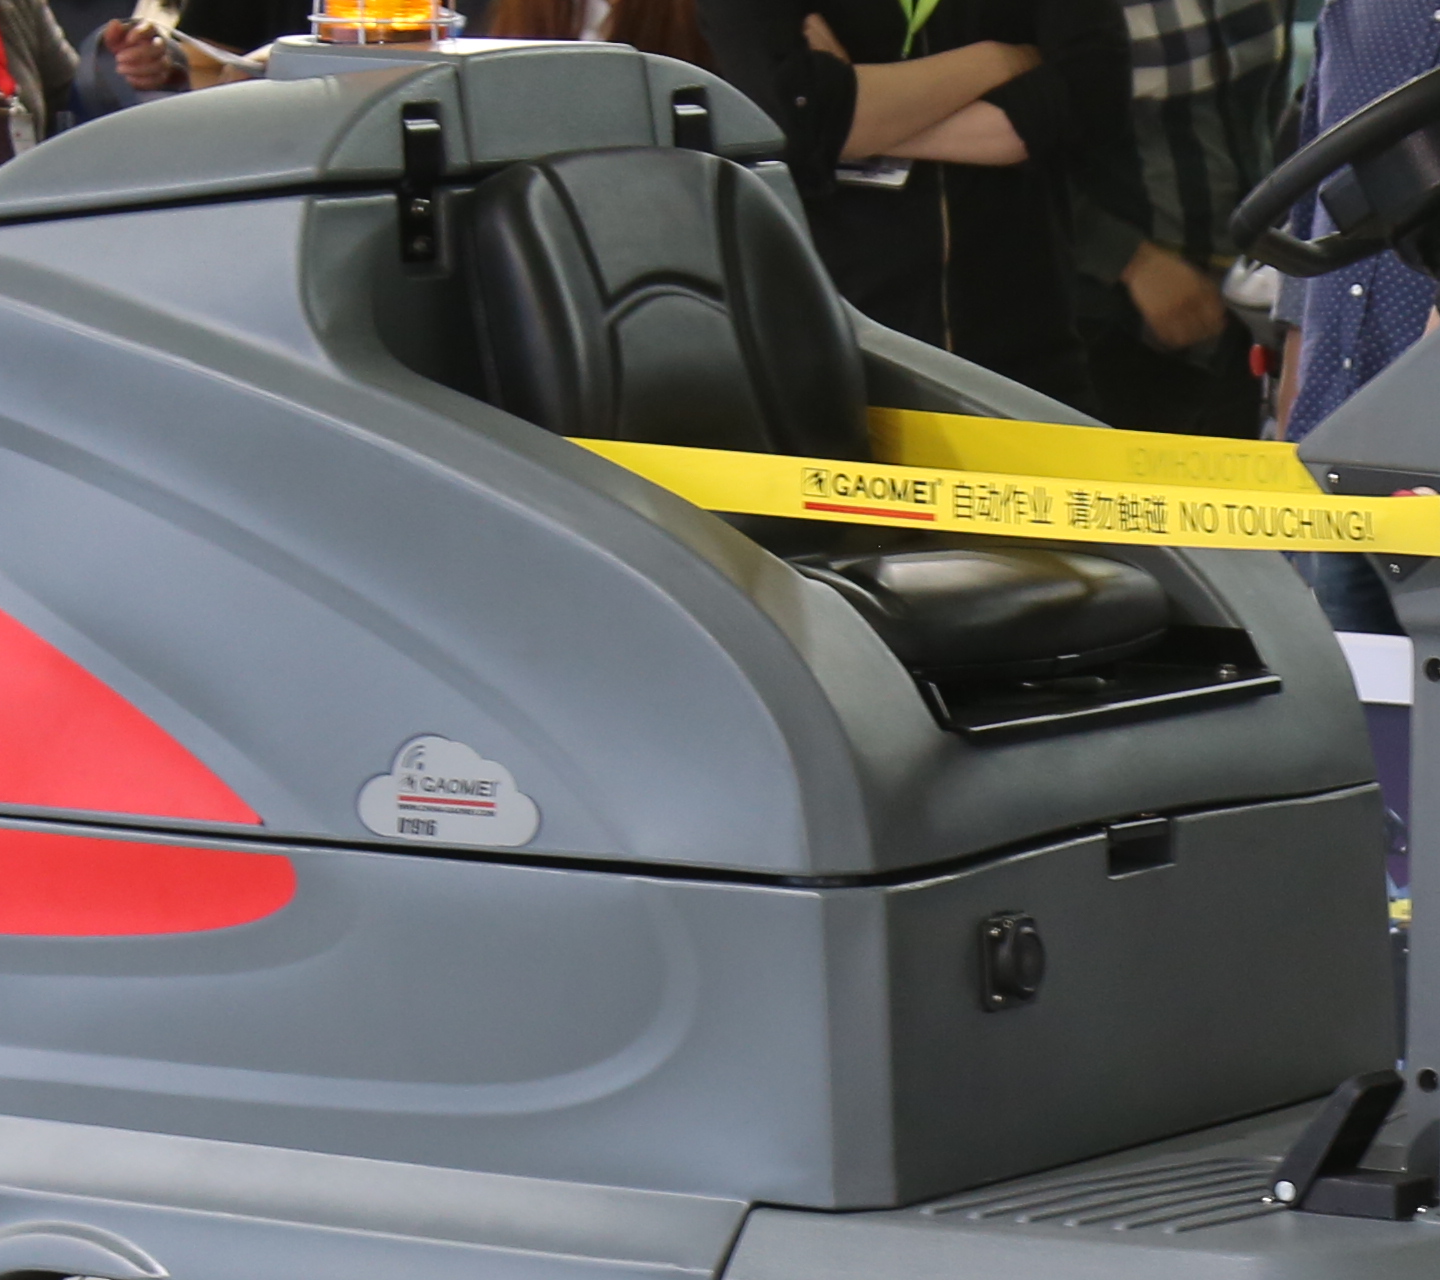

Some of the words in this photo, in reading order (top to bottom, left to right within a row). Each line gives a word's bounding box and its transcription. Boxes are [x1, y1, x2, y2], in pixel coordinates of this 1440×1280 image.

[832, 472, 937, 506] GAOMEI
[953, 480, 1054, 526] 自动作业
[1063, 489, 1170, 535] 请勿触碰
[1178, 500, 1220, 534] NO
[1222, 503, 1376, 542] TOUCHING!
